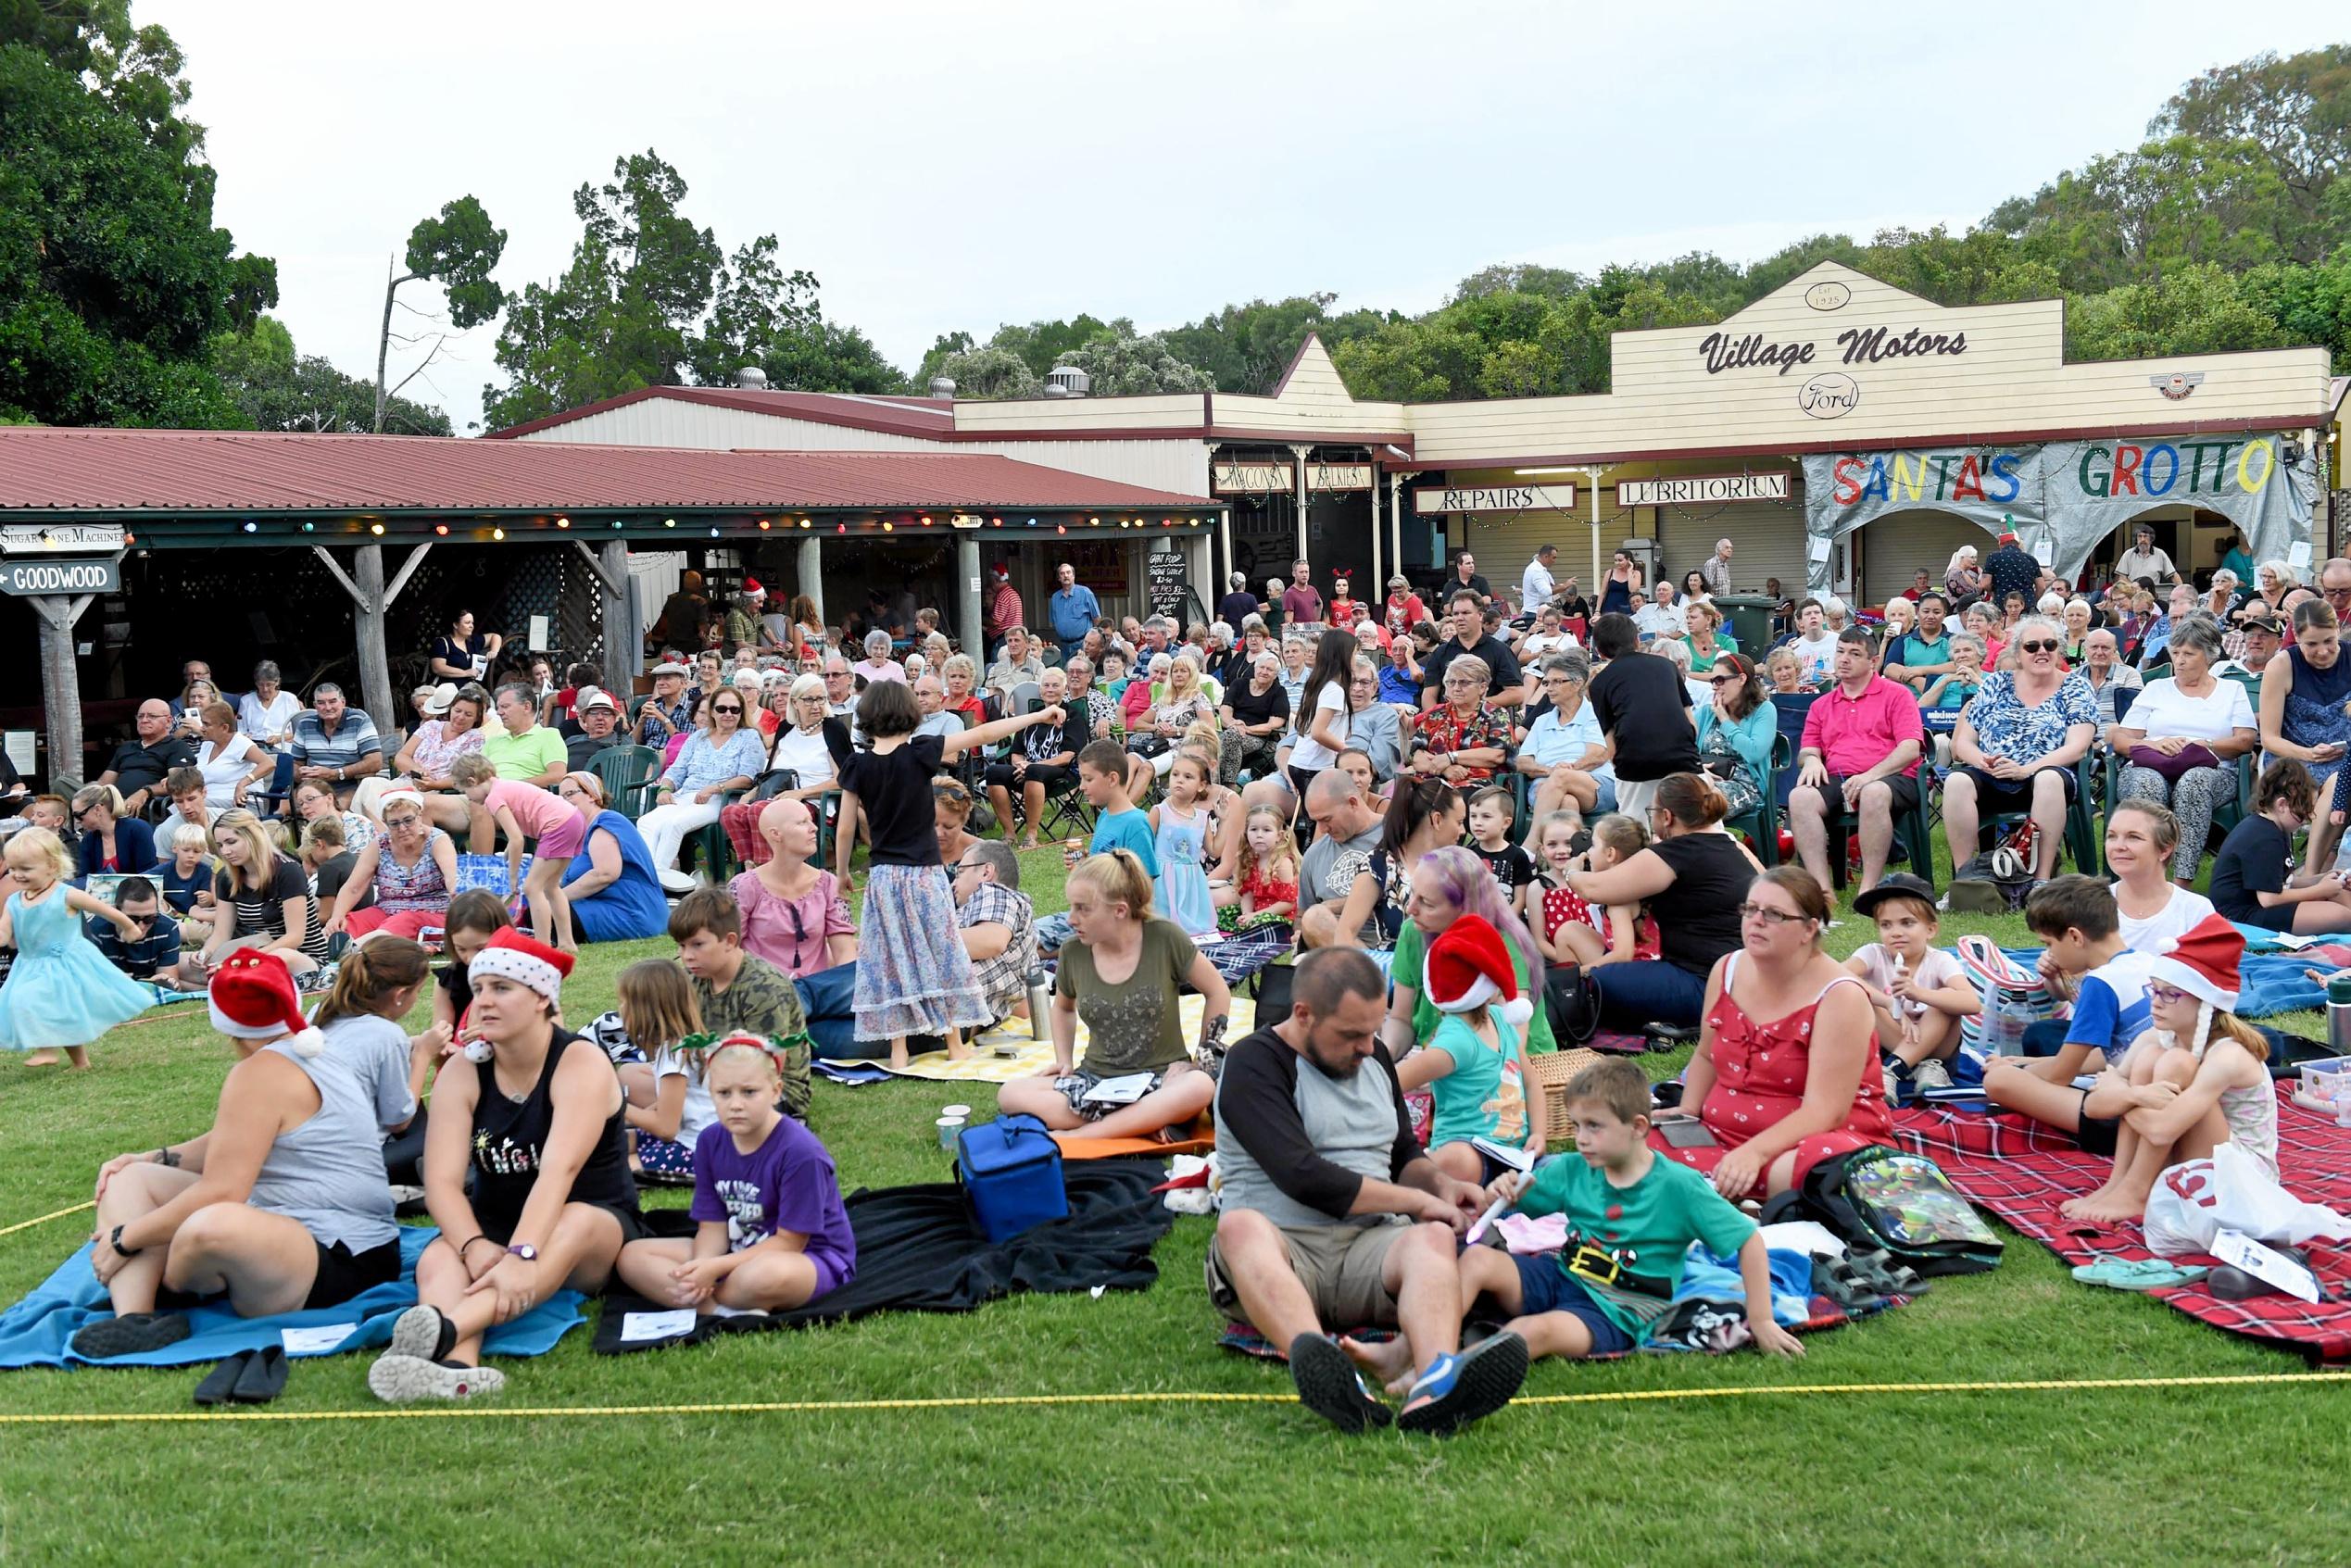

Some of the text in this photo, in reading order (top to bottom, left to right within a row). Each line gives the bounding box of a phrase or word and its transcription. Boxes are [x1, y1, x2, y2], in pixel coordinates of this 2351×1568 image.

[1815, 296, 1840, 306] 1925
[1699, 326, 1968, 376] Village Motors
[1804, 383, 1854, 410] Ford
[1833, 433, 2274, 506] SANTA'S GROTTO
[1443, 486, 1533, 510] REPAIRS
[1624, 474, 1788, 505] LUBRITORIUM
[0, 528, 38, 544] SUGAR
[72, 528, 127, 543] MACHINER
[1165, 555, 1182, 564] FOOD
[13, 566, 108, 590] GOODWOOD
